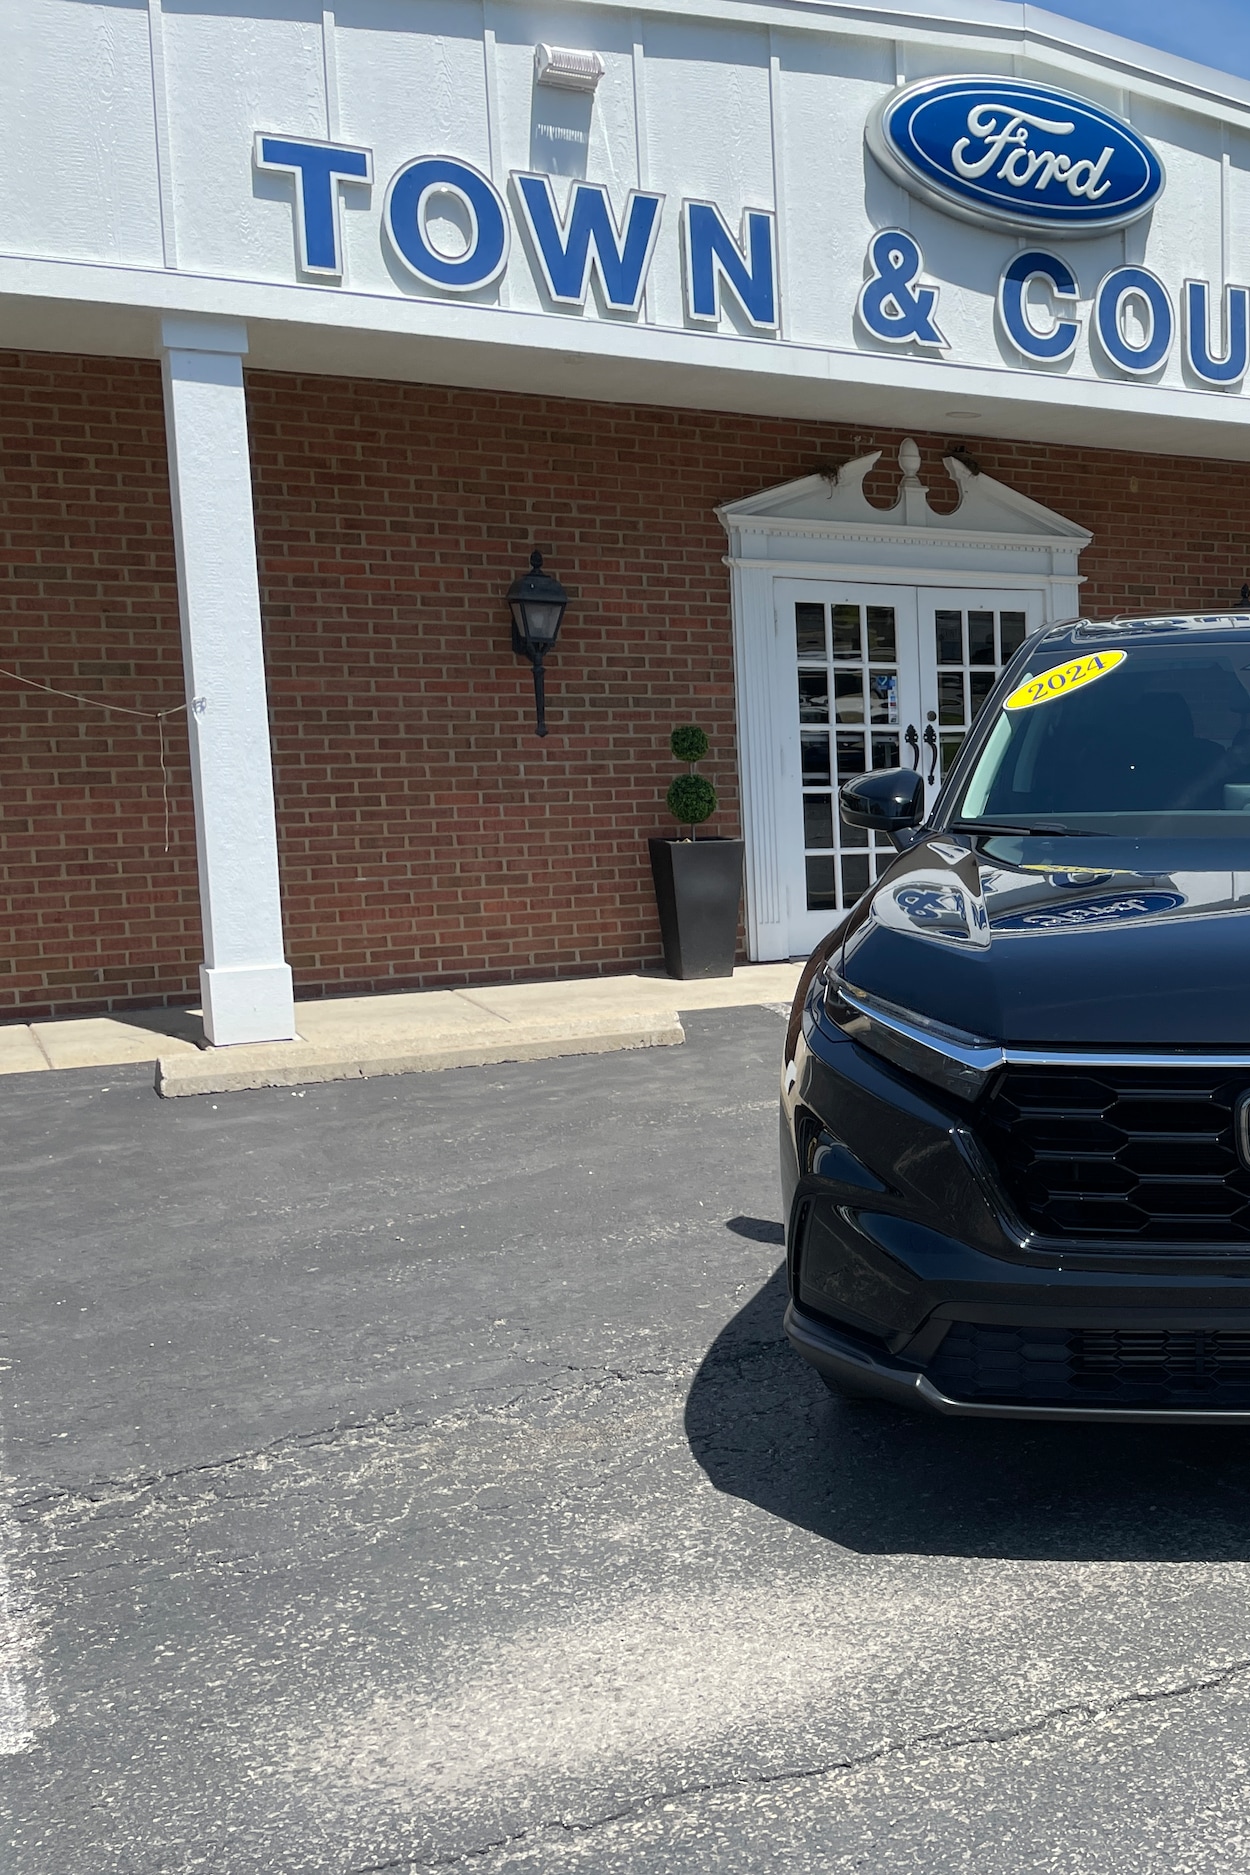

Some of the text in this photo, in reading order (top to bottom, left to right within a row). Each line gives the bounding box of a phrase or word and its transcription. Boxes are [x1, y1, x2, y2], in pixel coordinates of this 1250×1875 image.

[949, 103, 1115, 200] Ford
[254, 132, 779, 330] TOWN
[858, 228, 951, 349] &
[1027, 656, 1107, 702] 2024
